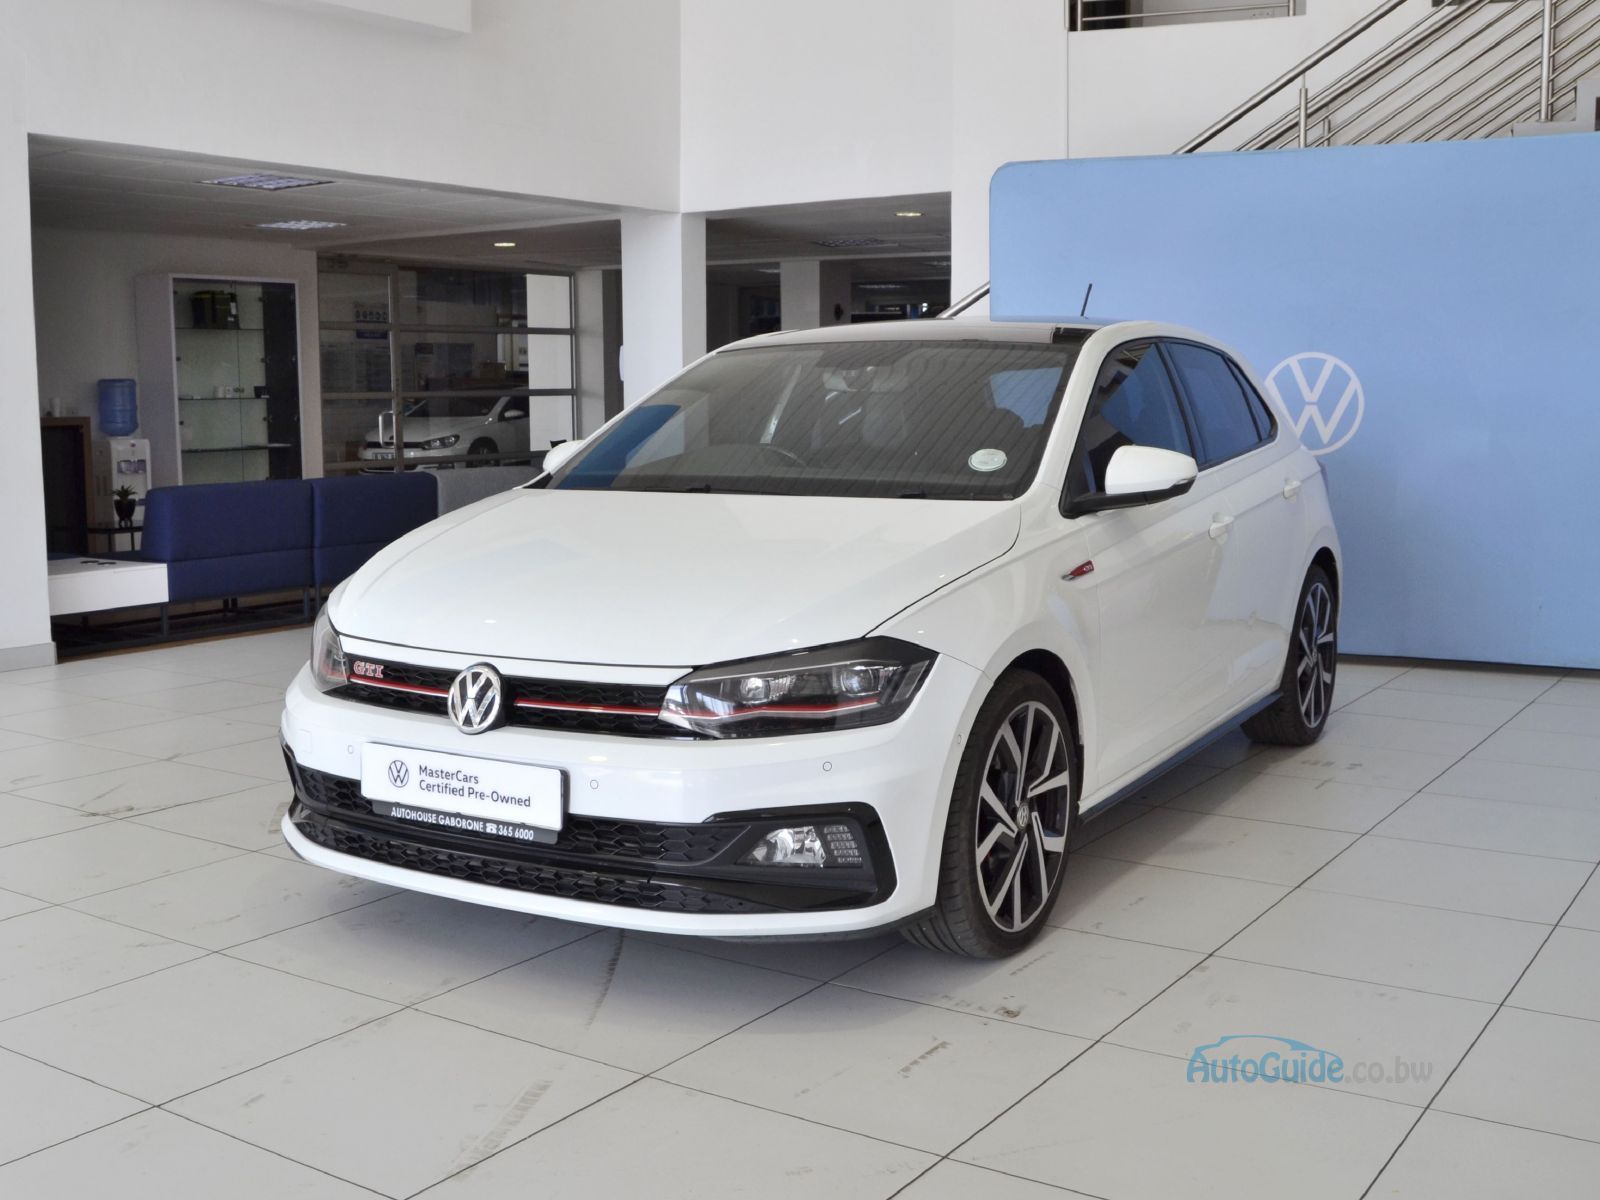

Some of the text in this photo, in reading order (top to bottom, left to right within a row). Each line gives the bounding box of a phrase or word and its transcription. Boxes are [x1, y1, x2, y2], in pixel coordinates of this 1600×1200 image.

[353, 660, 385, 679] GTI
[419, 765, 479, 784] MasterCars
[419, 779, 532, 808] Certified Pre-Owned
[391, 807, 534, 841] AUTOHOUSE GABORONE 365 6000
